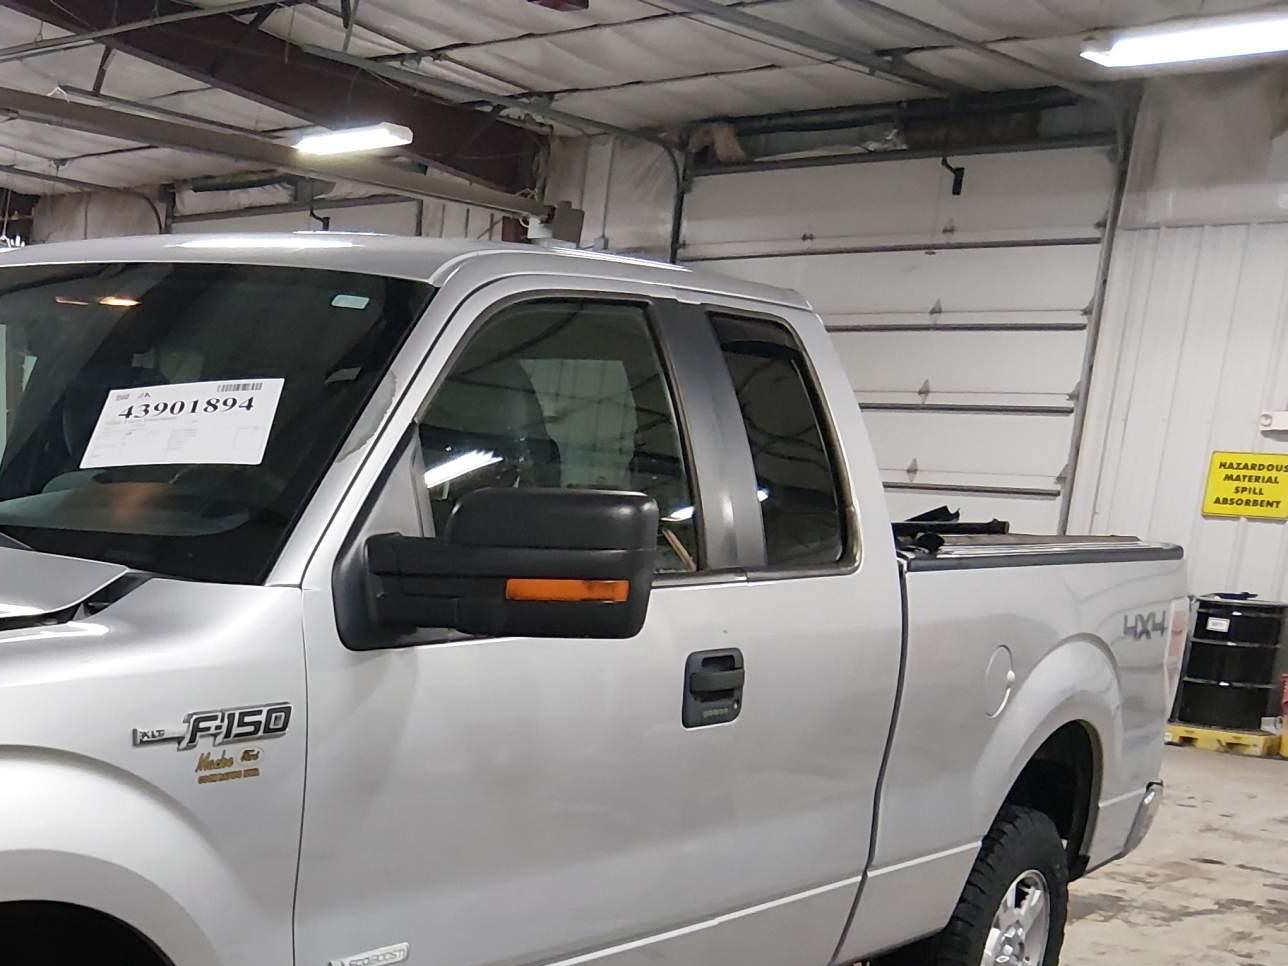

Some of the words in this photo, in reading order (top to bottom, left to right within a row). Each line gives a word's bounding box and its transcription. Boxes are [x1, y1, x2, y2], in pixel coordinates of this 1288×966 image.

[118, 396, 255, 419] 43901894
[1218, 461, 1288, 473] HAZARDOUS
[1223, 473, 1280, 484] MATERIAL
[1233, 486, 1265, 496] SPILL
[1213, 496, 1282, 509] ABSORBENT
[186, 704, 293, 746] F-150
